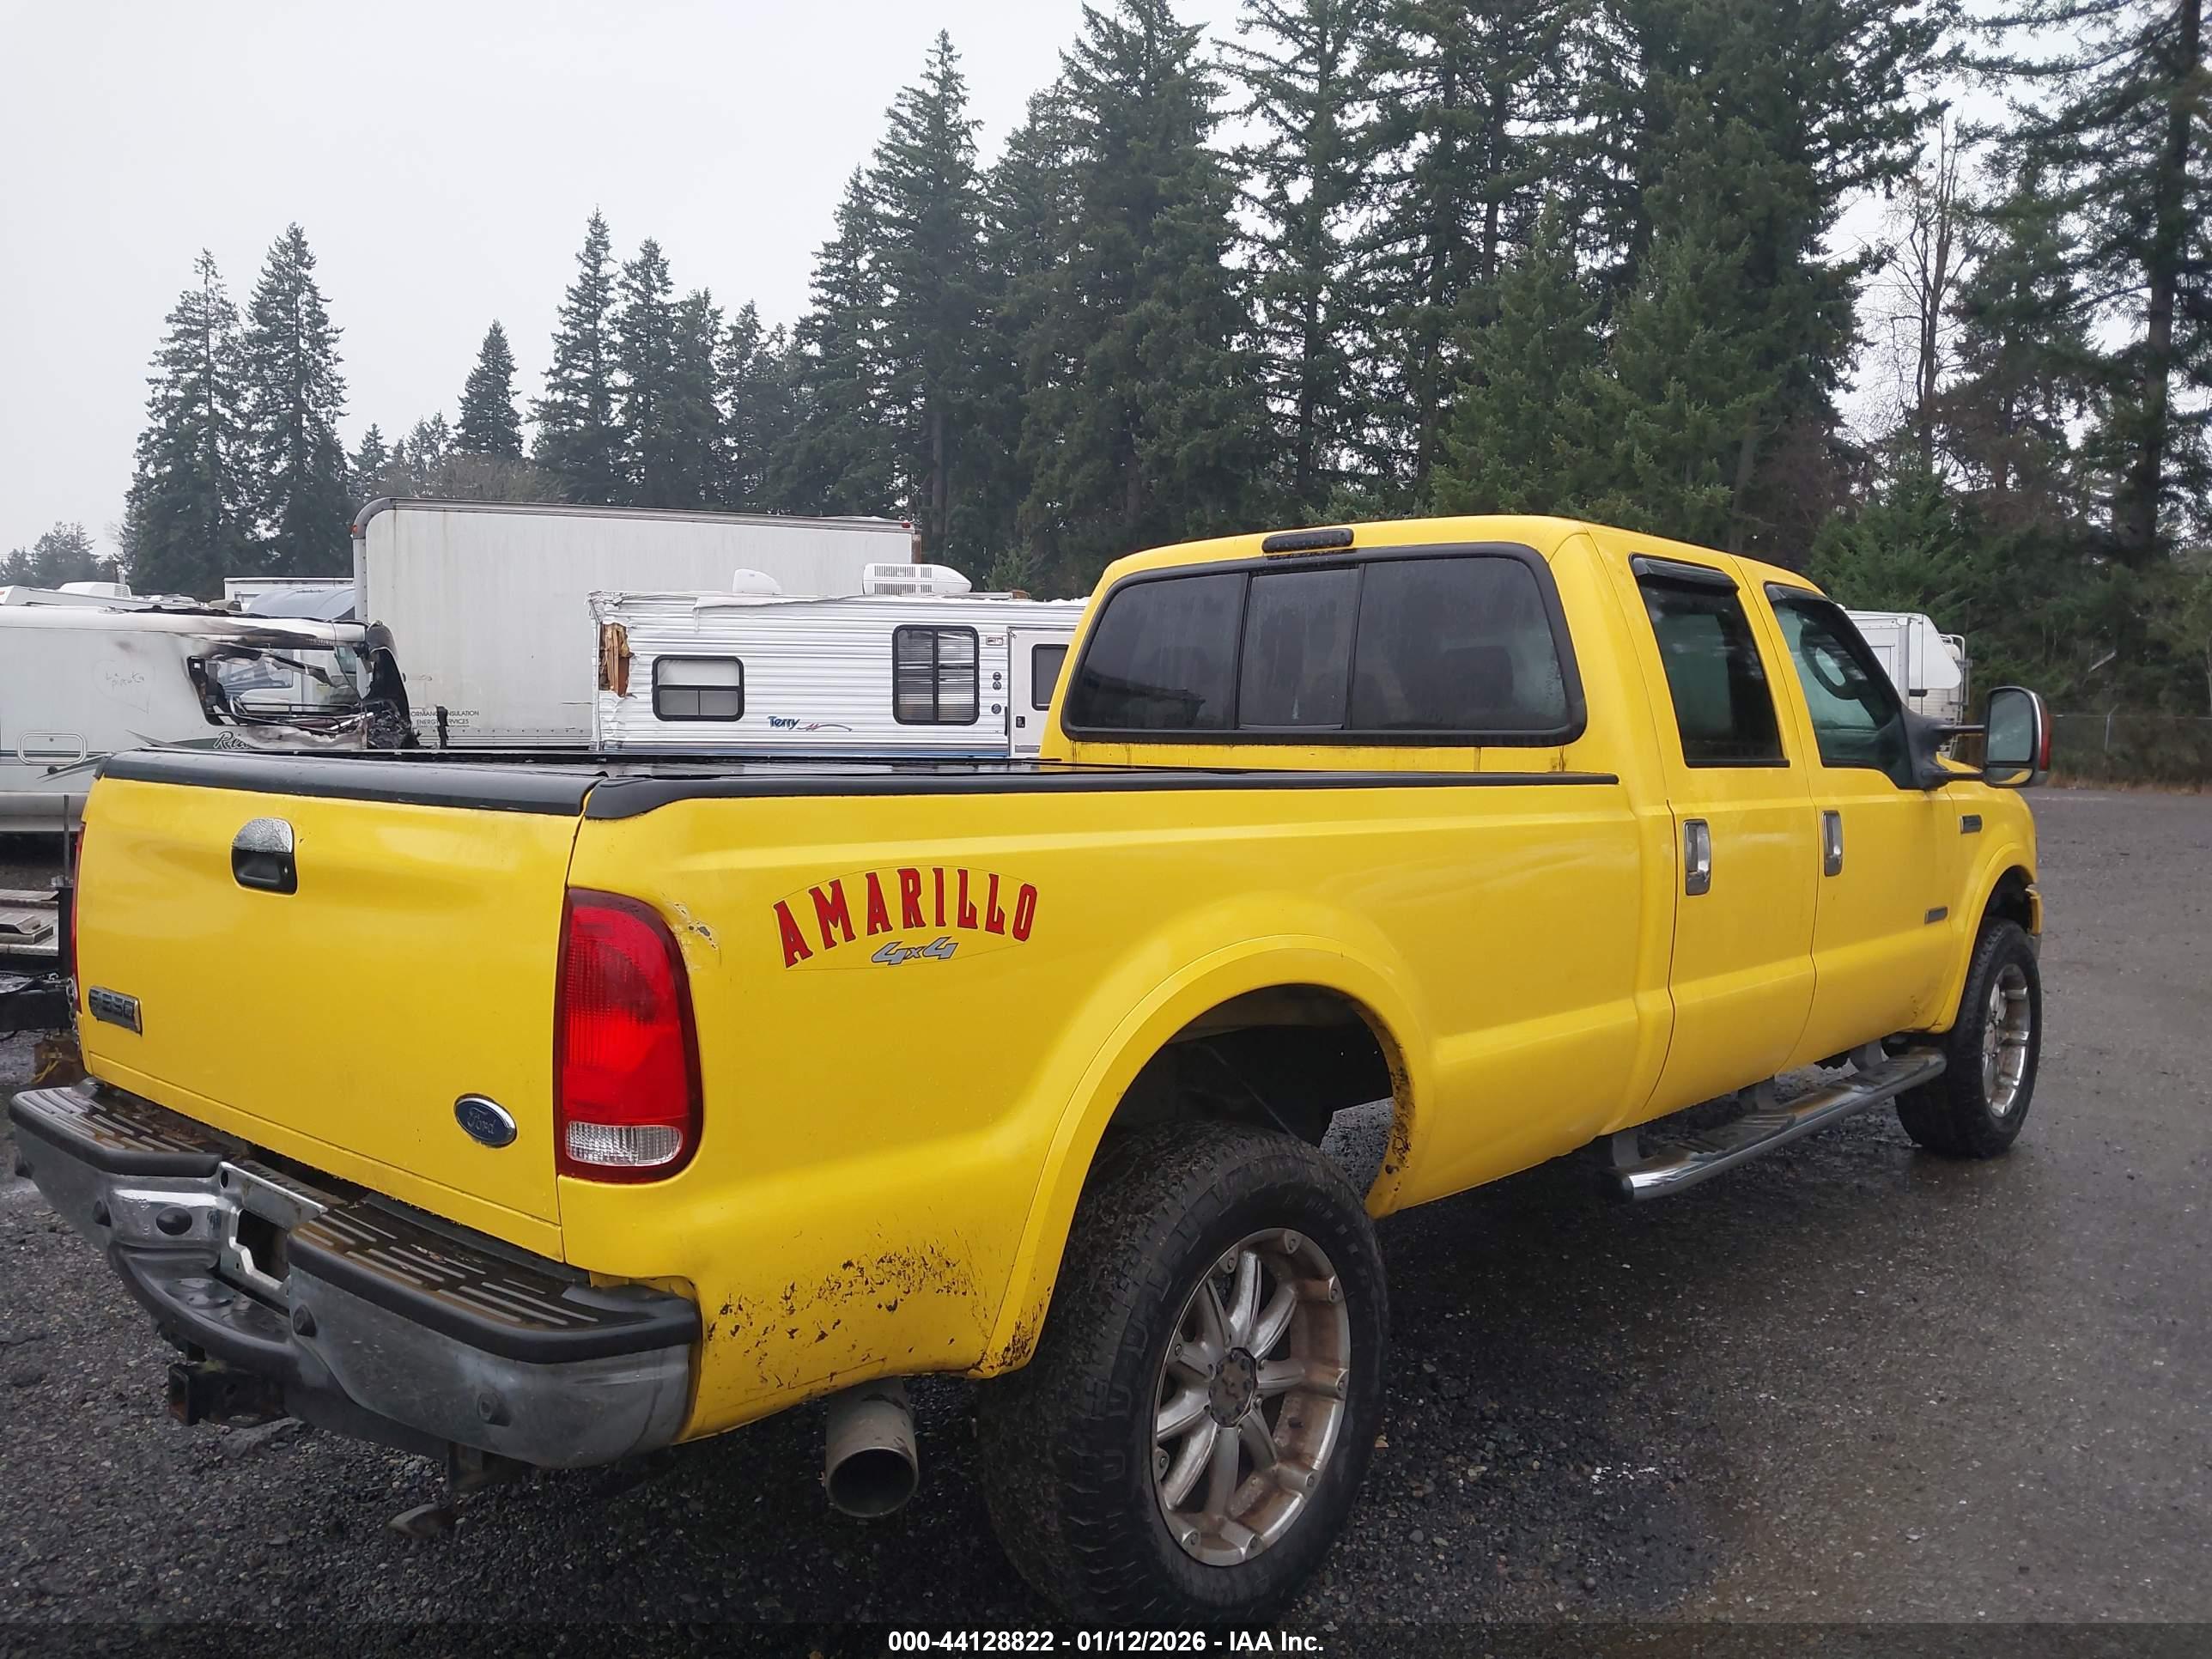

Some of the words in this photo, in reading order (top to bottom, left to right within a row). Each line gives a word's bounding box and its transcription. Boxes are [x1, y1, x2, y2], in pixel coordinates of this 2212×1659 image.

[767, 715, 801, 730] Terry
[773, 867, 1038, 969] AMARILLO
[872, 936, 959, 966] 4x4
[466, 1106, 498, 1134] Ford
